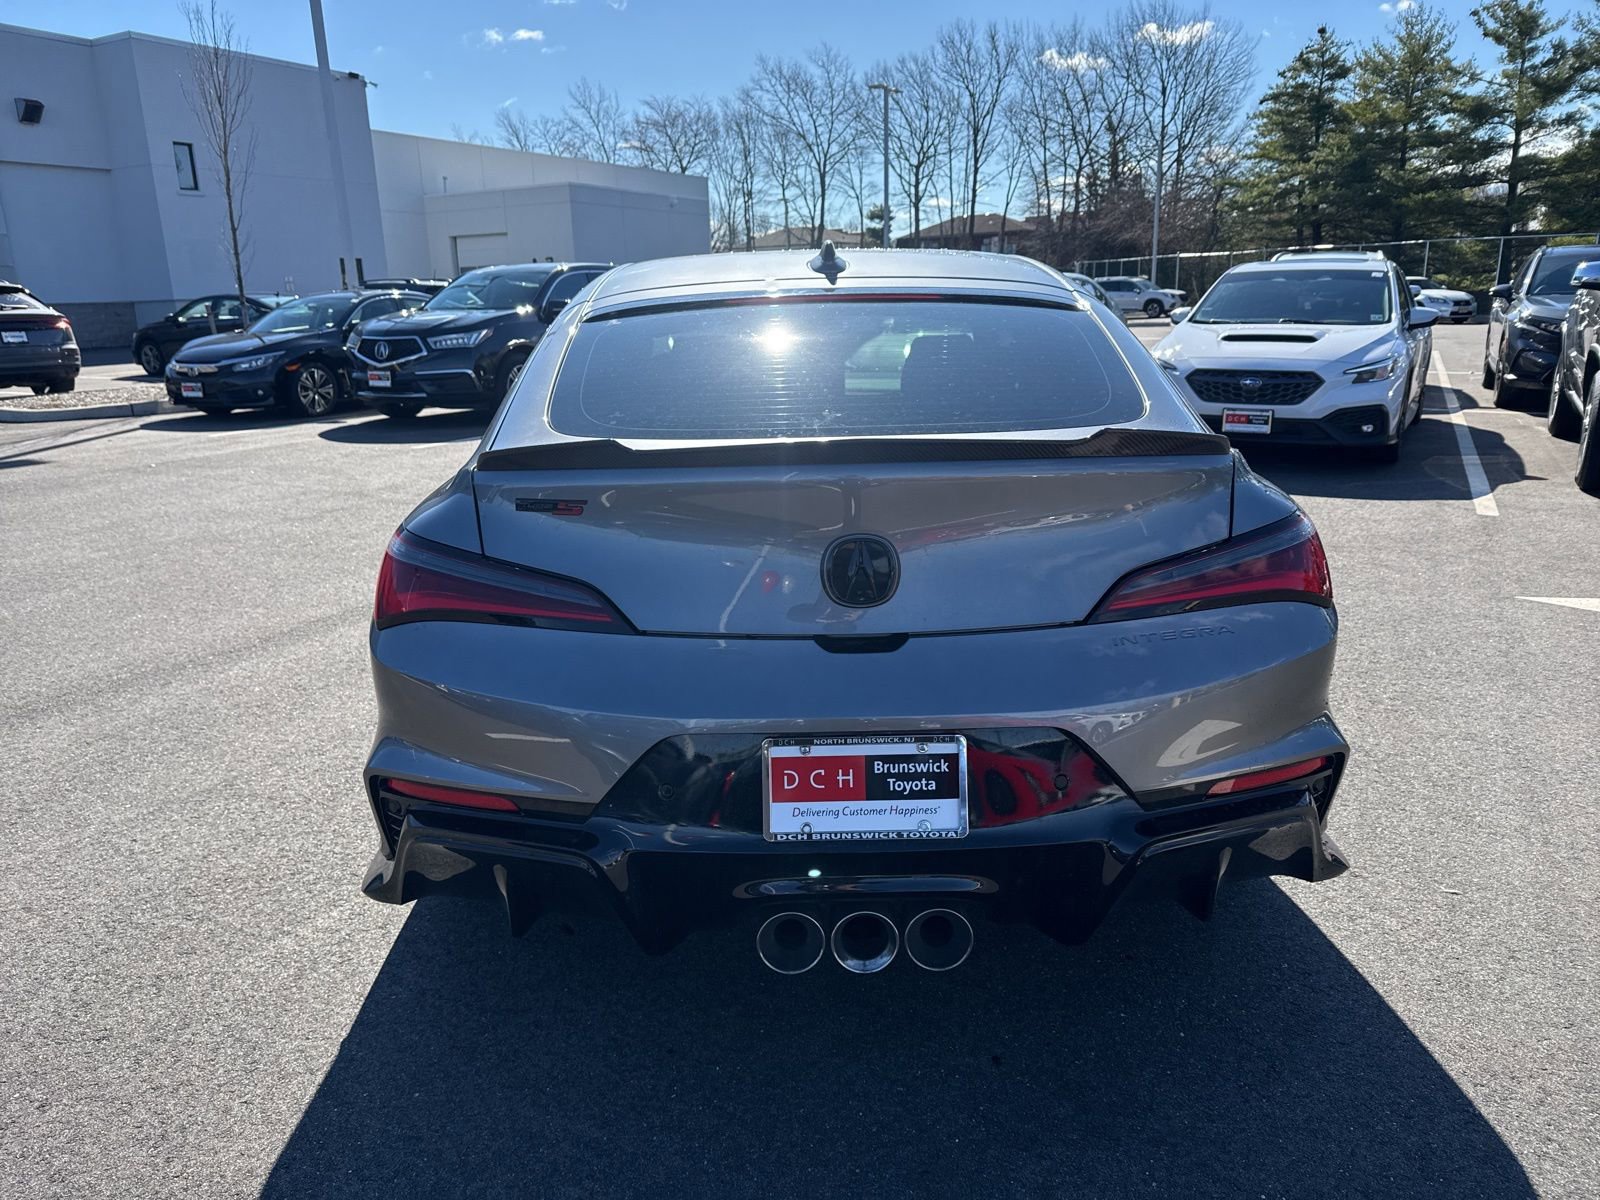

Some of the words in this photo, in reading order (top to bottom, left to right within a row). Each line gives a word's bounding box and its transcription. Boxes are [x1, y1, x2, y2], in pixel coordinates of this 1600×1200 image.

[1112, 625, 1235, 647] INTEGRA
[874, 759, 950, 774] Brunswick
[887, 778, 936, 795] Toyota
[792, 807, 840, 819] Delivering
[842, 805, 888, 816] Customer
[812, 832, 898, 840] BRUNSWICK
[900, 831, 957, 839] TOYOTA
